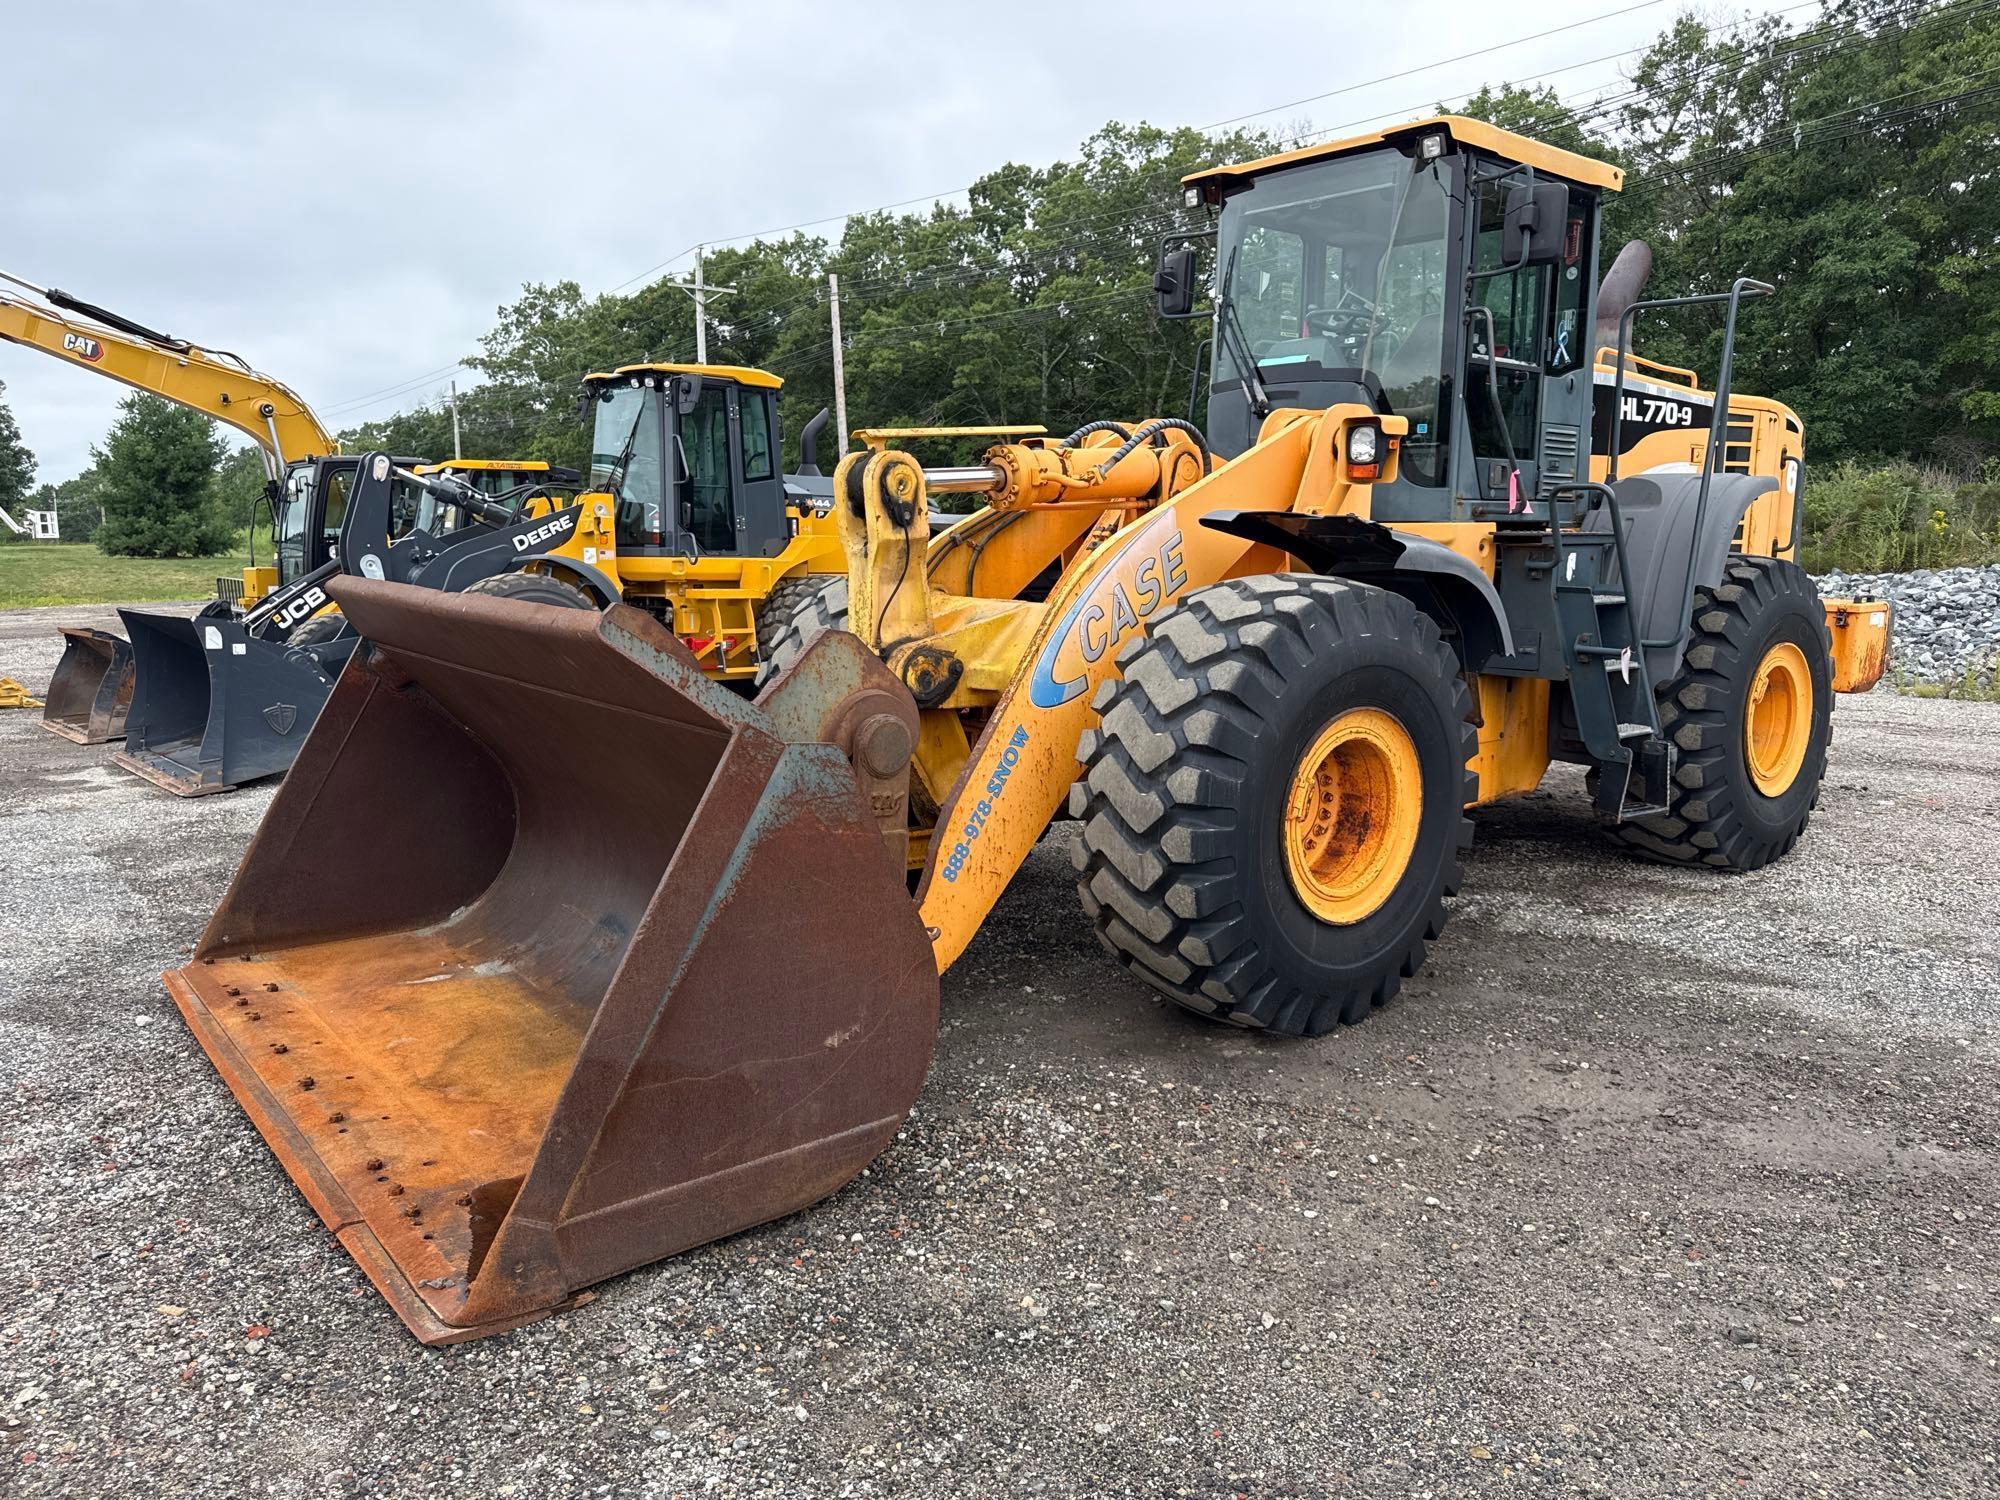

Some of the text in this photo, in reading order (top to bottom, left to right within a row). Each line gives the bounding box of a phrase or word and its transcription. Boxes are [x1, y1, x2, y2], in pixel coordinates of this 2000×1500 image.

[63, 333, 96, 356] CAT
[1620, 396, 1692, 426] HL770-9
[511, 514, 574, 552] DEERE
[277, 586, 326, 629] JCB
[1079, 530, 1188, 663] CASE
[942, 723, 1030, 883] 888-978-SNOW
